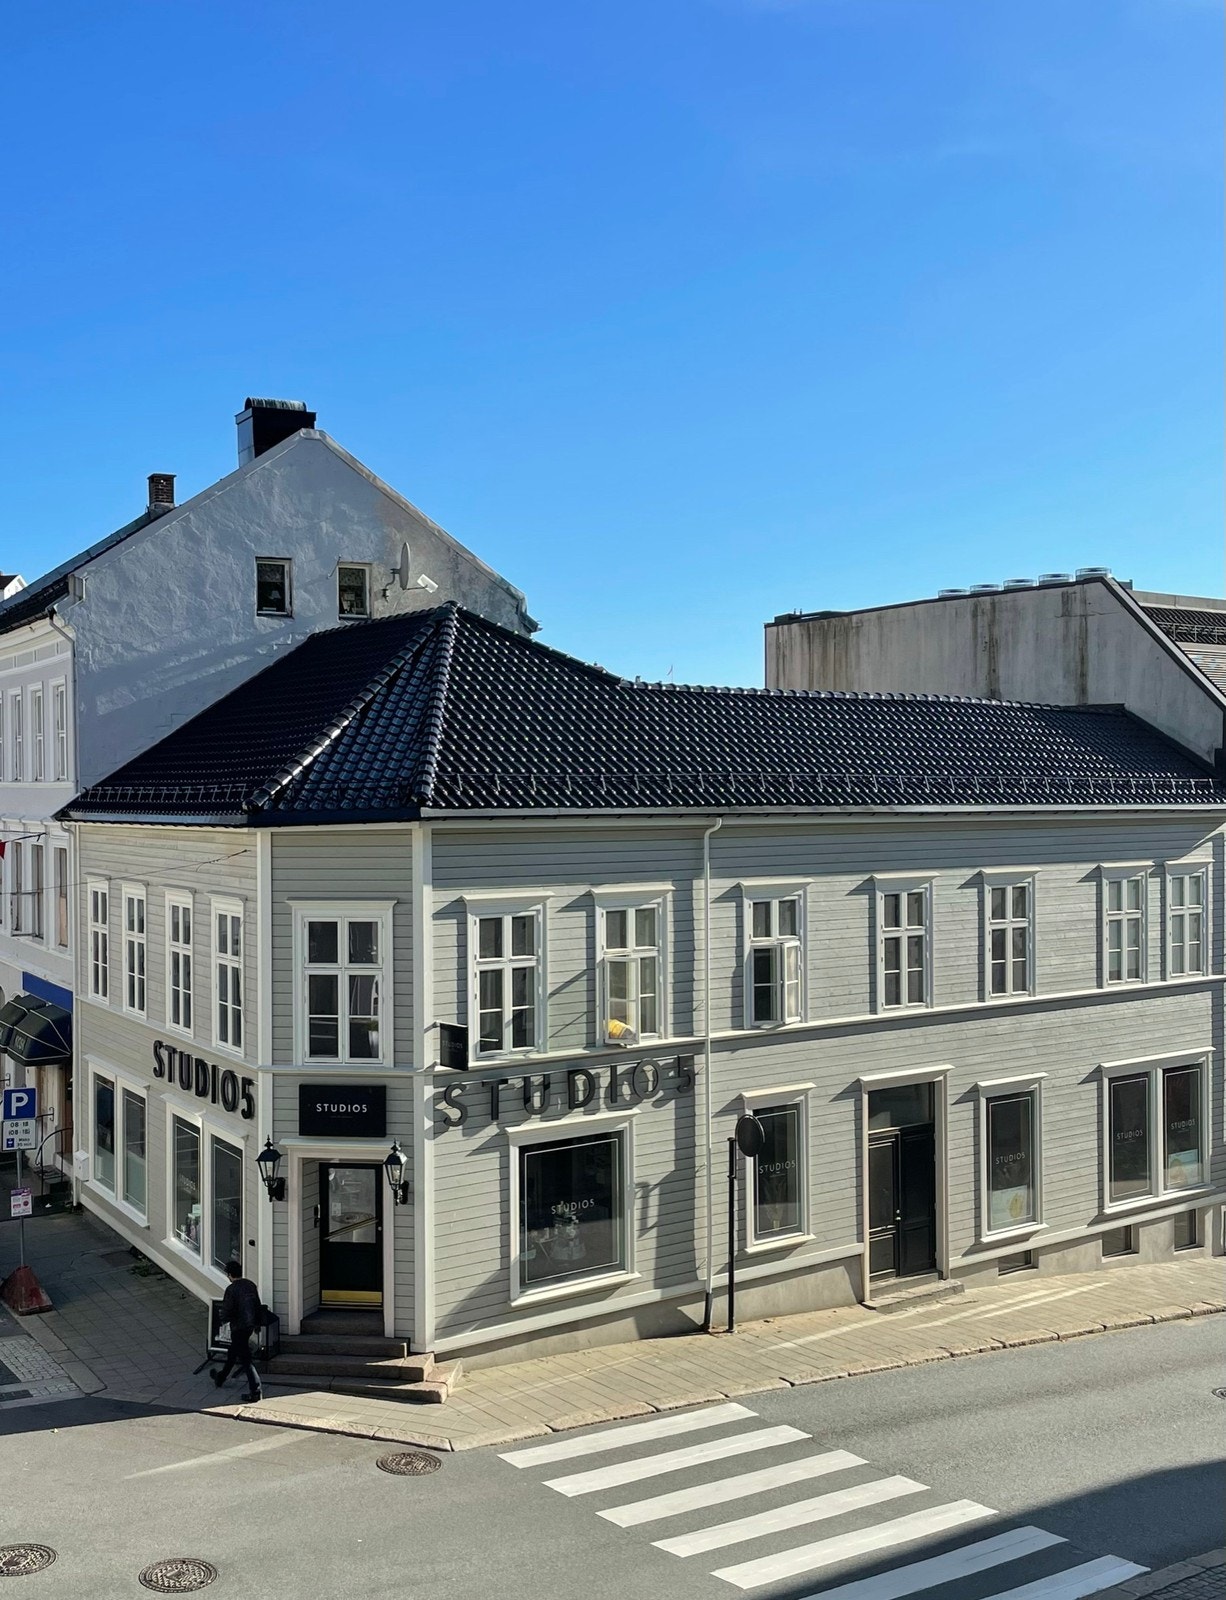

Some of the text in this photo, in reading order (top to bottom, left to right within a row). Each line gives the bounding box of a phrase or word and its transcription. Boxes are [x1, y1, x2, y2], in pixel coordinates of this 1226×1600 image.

[11, 1092, 29, 1116] P
[153, 1040, 255, 1120] STUDIO5
[443, 1055, 692, 1127] STUDIO5
